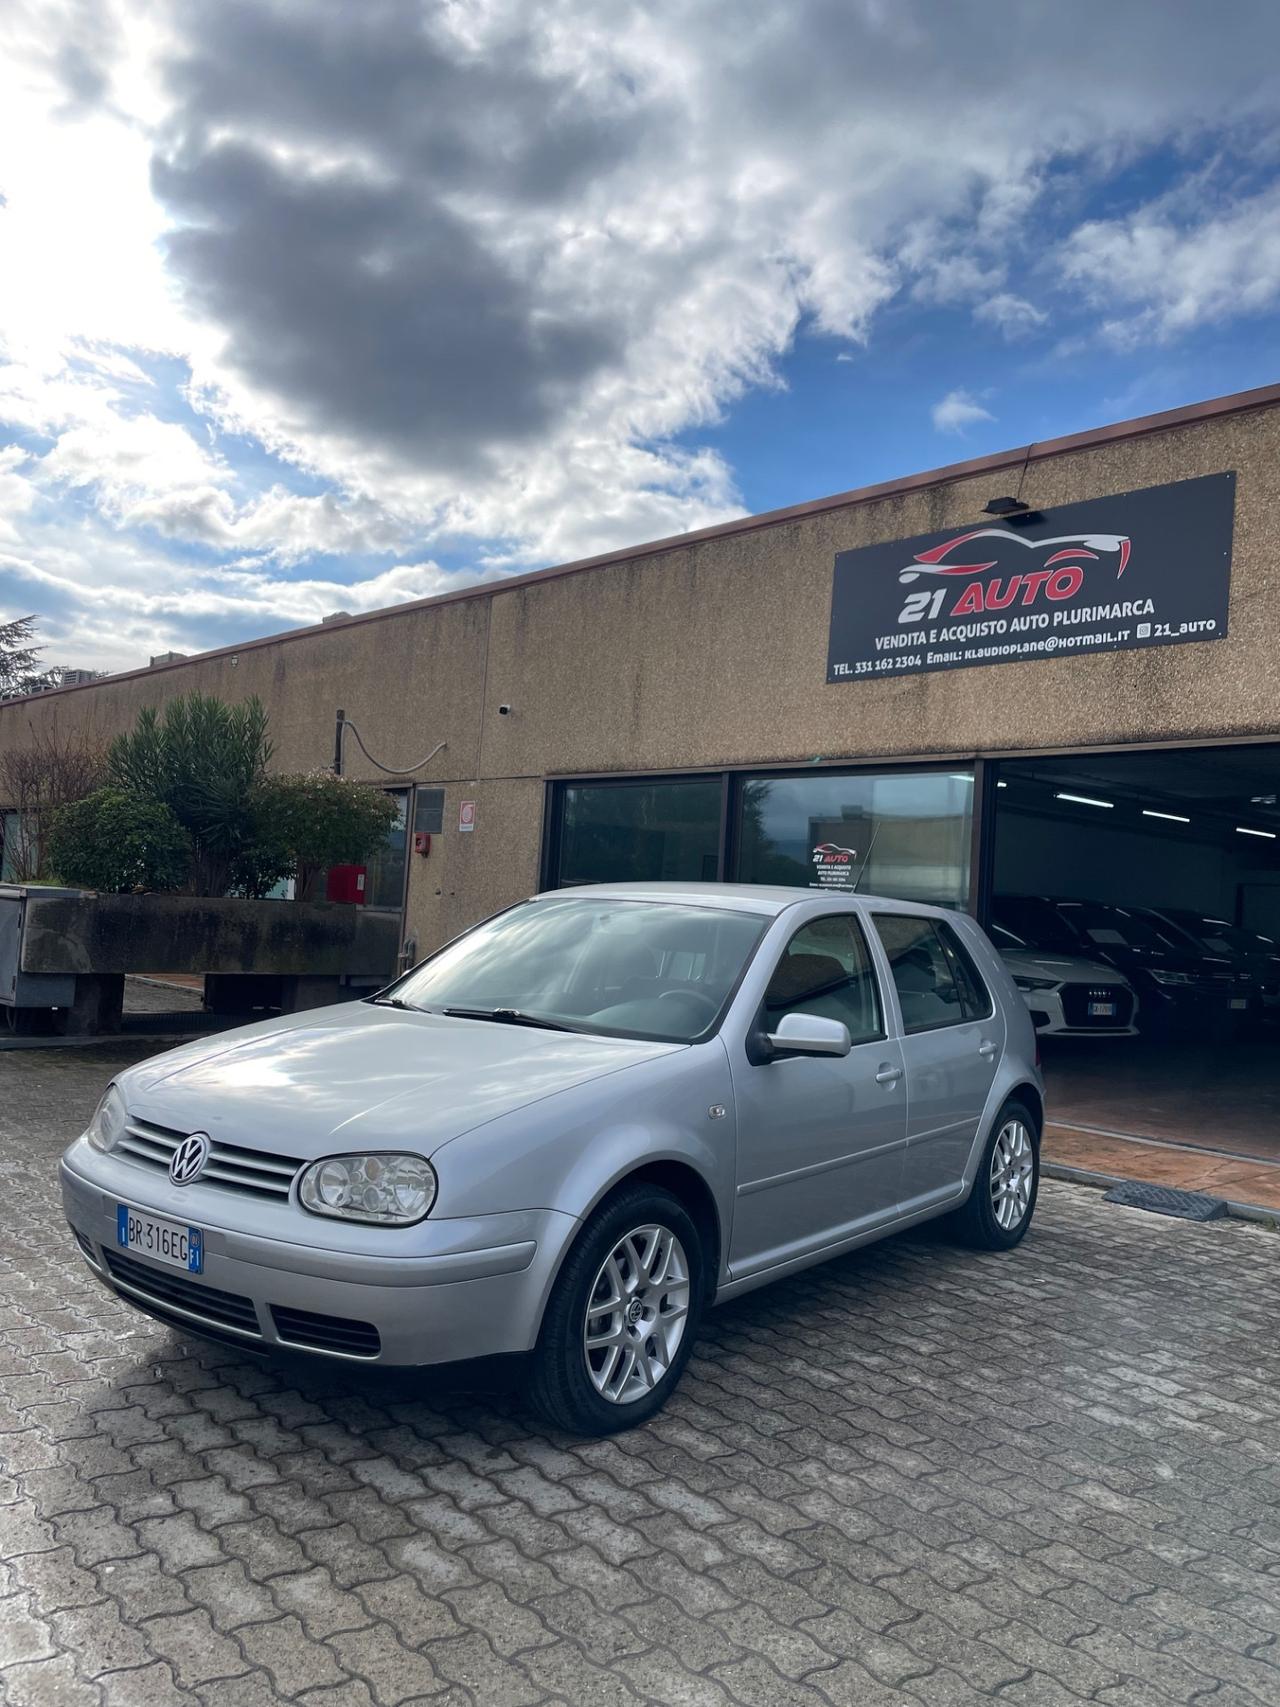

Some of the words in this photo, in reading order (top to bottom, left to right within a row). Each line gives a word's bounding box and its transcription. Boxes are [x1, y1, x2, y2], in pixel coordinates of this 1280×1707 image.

[898, 588, 947, 624] 21
[950, 566, 1084, 616] AUTO
[875, 631, 927, 651] VENDITA
[930, 629, 937, 643] E
[939, 619, 1007, 642] ACQUISTO
[1010, 613, 1049, 633] AUTO
[1053, 598, 1155, 627] PLURIMARCA
[833, 663, 853, 676] TEL.
[855, 660, 872, 674] 331
[874, 658, 893, 671] 162
[895, 654, 922, 668] 2304
